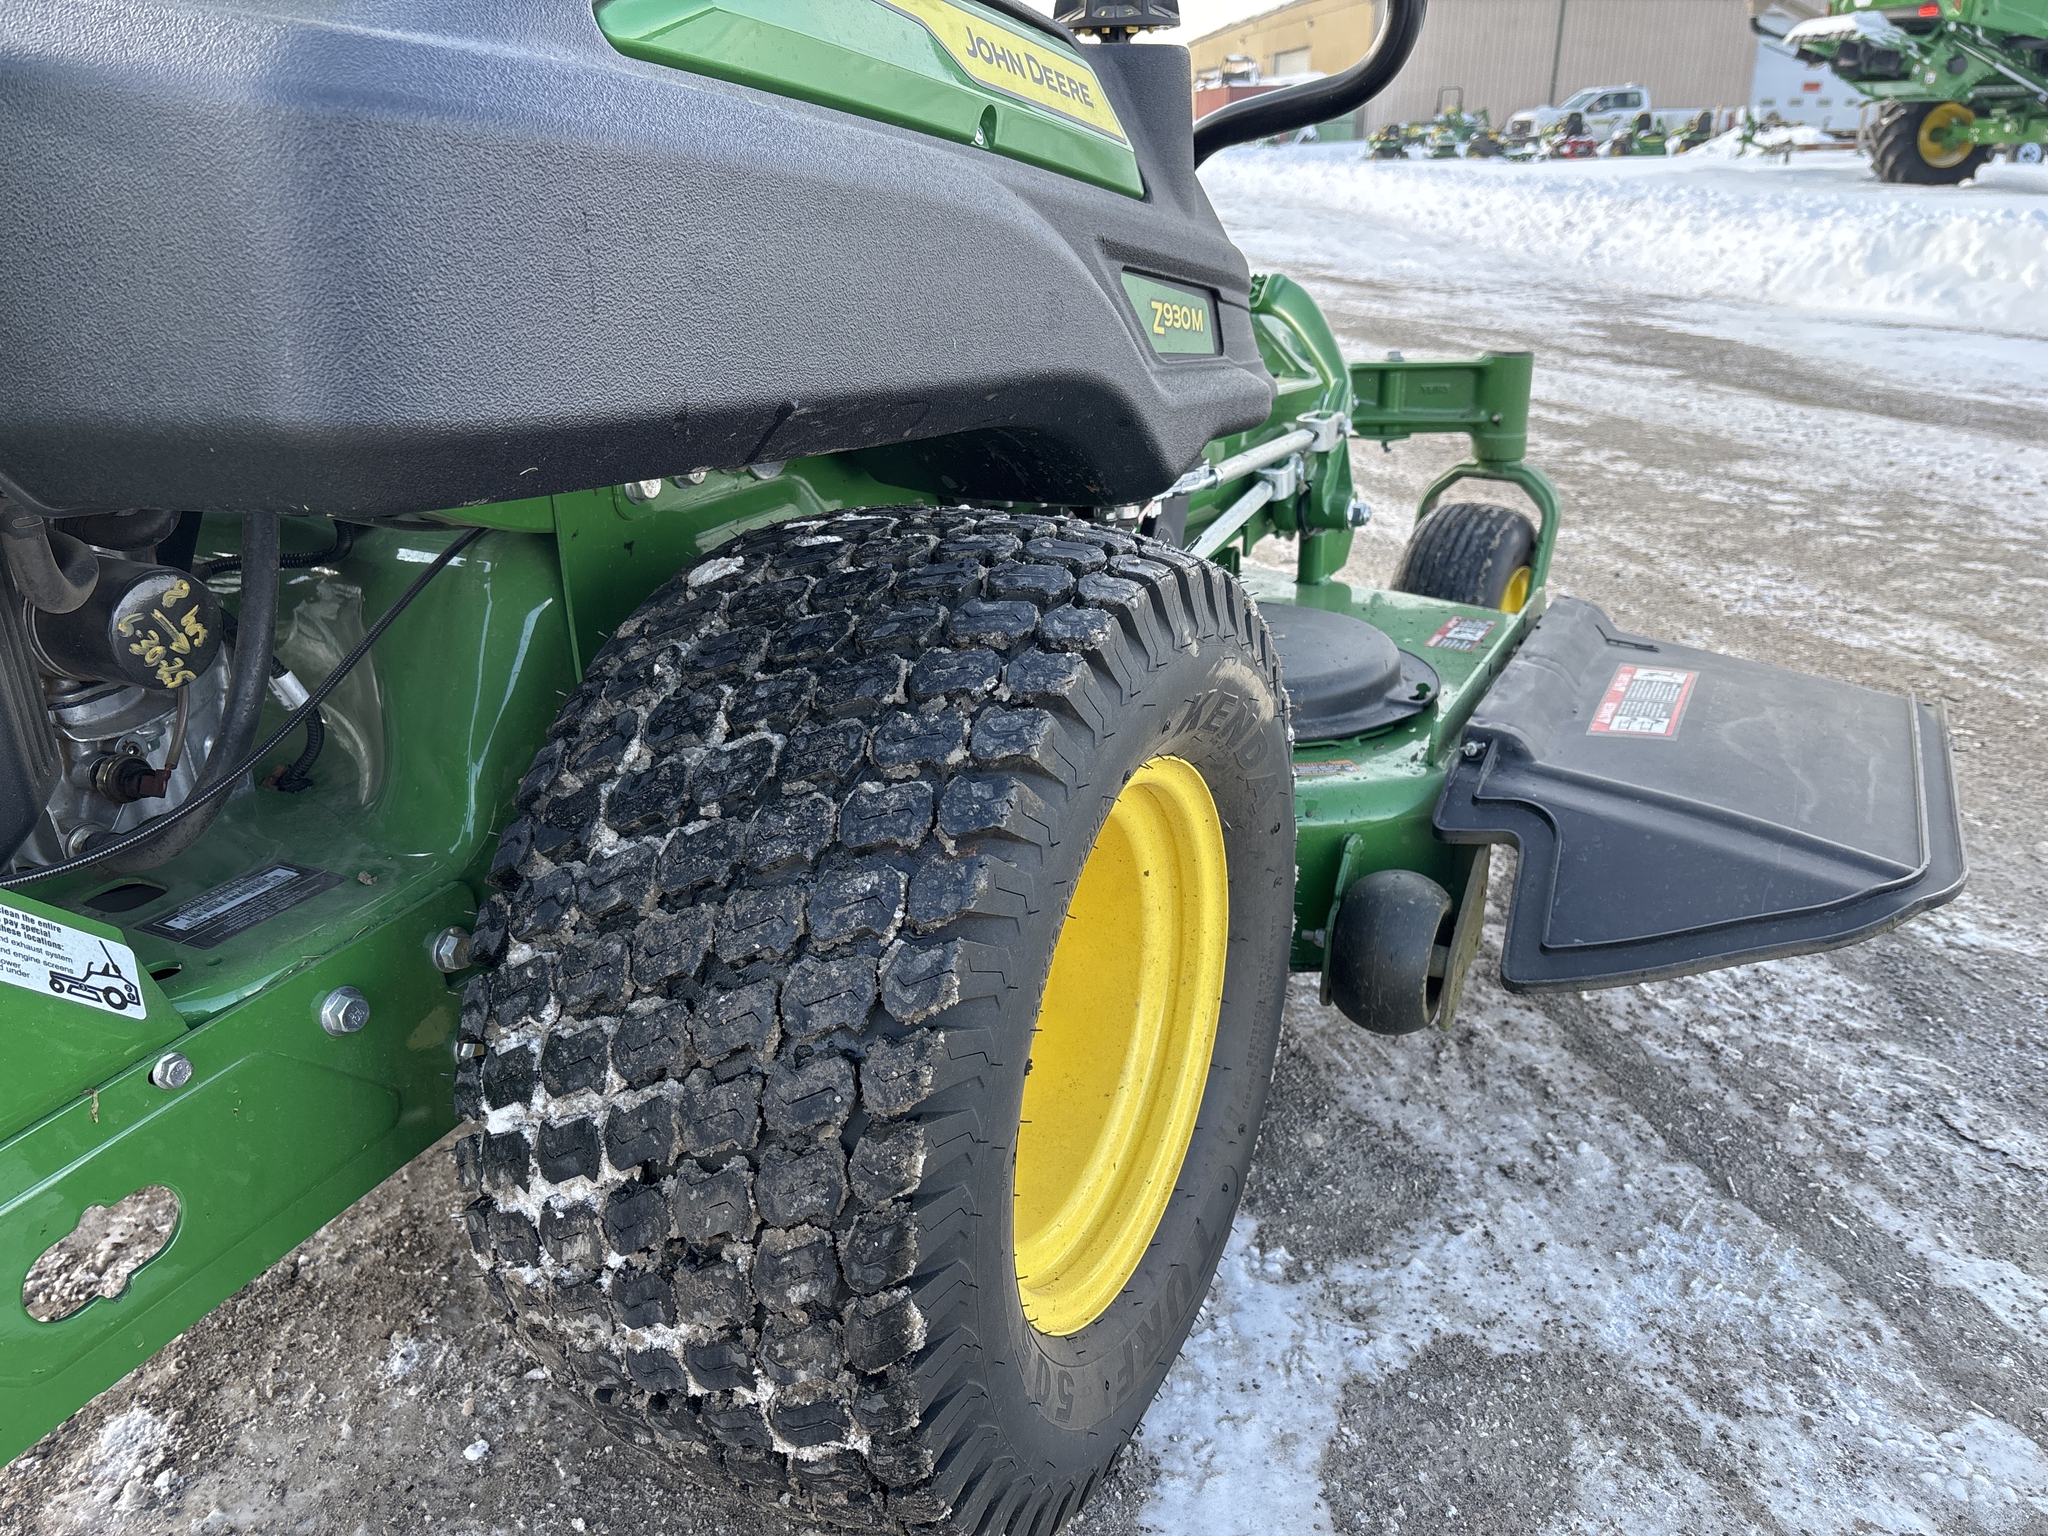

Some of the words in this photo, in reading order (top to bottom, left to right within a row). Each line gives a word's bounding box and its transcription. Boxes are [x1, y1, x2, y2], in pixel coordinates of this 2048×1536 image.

[966, 26, 1026, 79] JOHN
[1025, 52, 1094, 108] DEERE
[1151, 301, 1203, 334] Z930M
[1172, 688, 1279, 815] KENDA
[0, 906, 20, 920] lean
[22, 914, 35, 925] the
[38, 920, 62, 934] entire
[3, 917, 18, 929] pay
[21, 923, 51, 938] special
[11, 940, 43, 954] exhaust
[45, 950, 73, 964] system
[24, 932, 64, 951] locations:
[0, 958, 21, 969] ower
[6, 966, 30, 979] under
[13, 951, 41, 964] engine
[43, 960, 74, 974] screens
